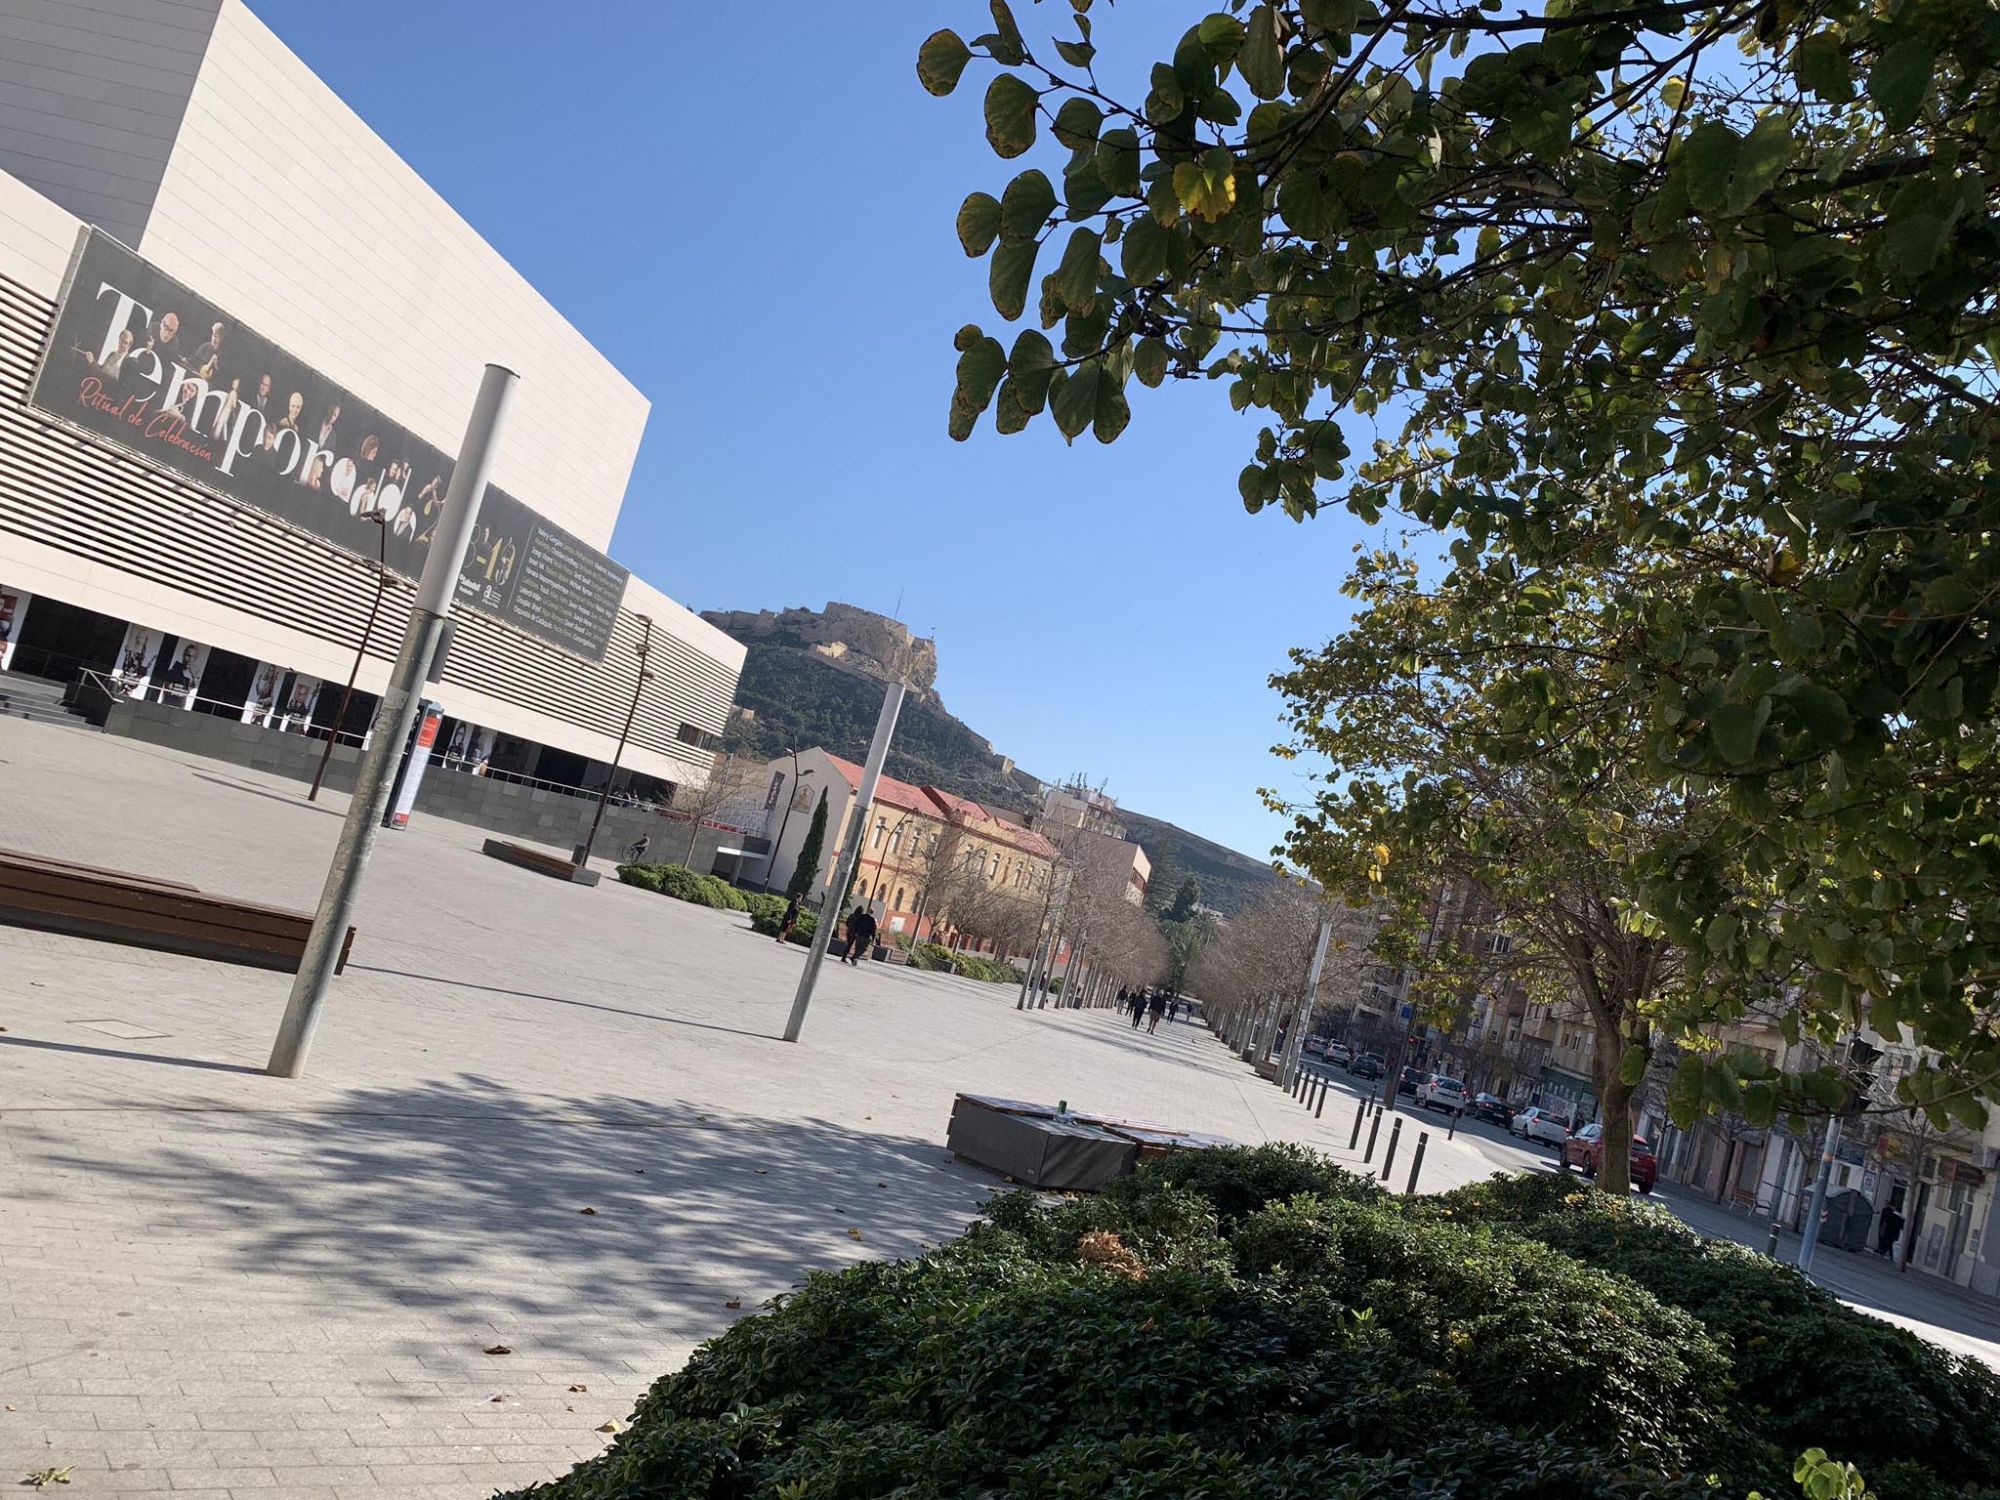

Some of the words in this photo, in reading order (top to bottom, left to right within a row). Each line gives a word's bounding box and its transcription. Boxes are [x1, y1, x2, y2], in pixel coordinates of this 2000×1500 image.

[79, 377, 135, 421] Ritual
[127, 401, 149, 426] de
[144, 412, 213, 461] Celebración
